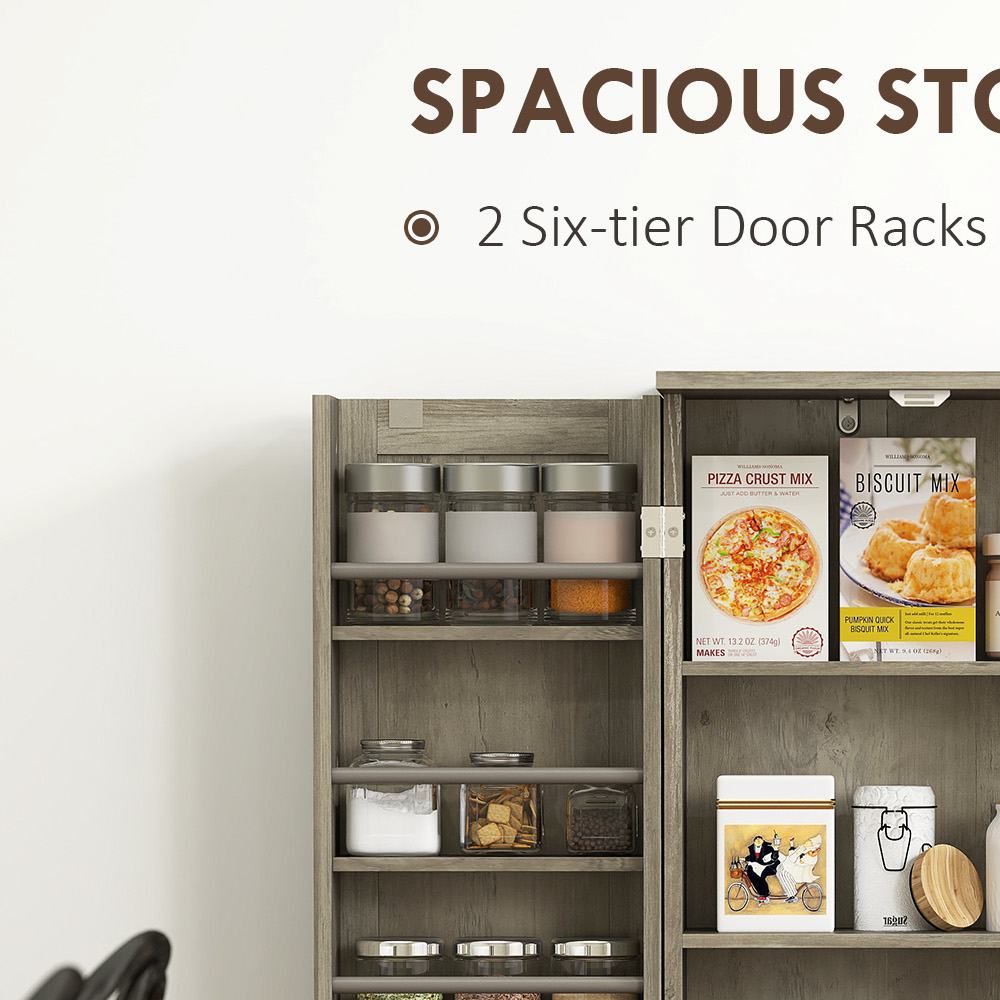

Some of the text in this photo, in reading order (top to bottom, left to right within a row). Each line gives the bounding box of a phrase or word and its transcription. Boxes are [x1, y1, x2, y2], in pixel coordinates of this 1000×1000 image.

[708, 473, 813, 485] PIZZA CRUST MIX
[856, 473, 960, 493] BISCUIT MIX
[844, 616, 895, 624] PUMPKIN QUICK
[696, 637, 781, 648] NET WT. 13.2 OZ. (374g)
[696, 649, 726, 657] MAKES
